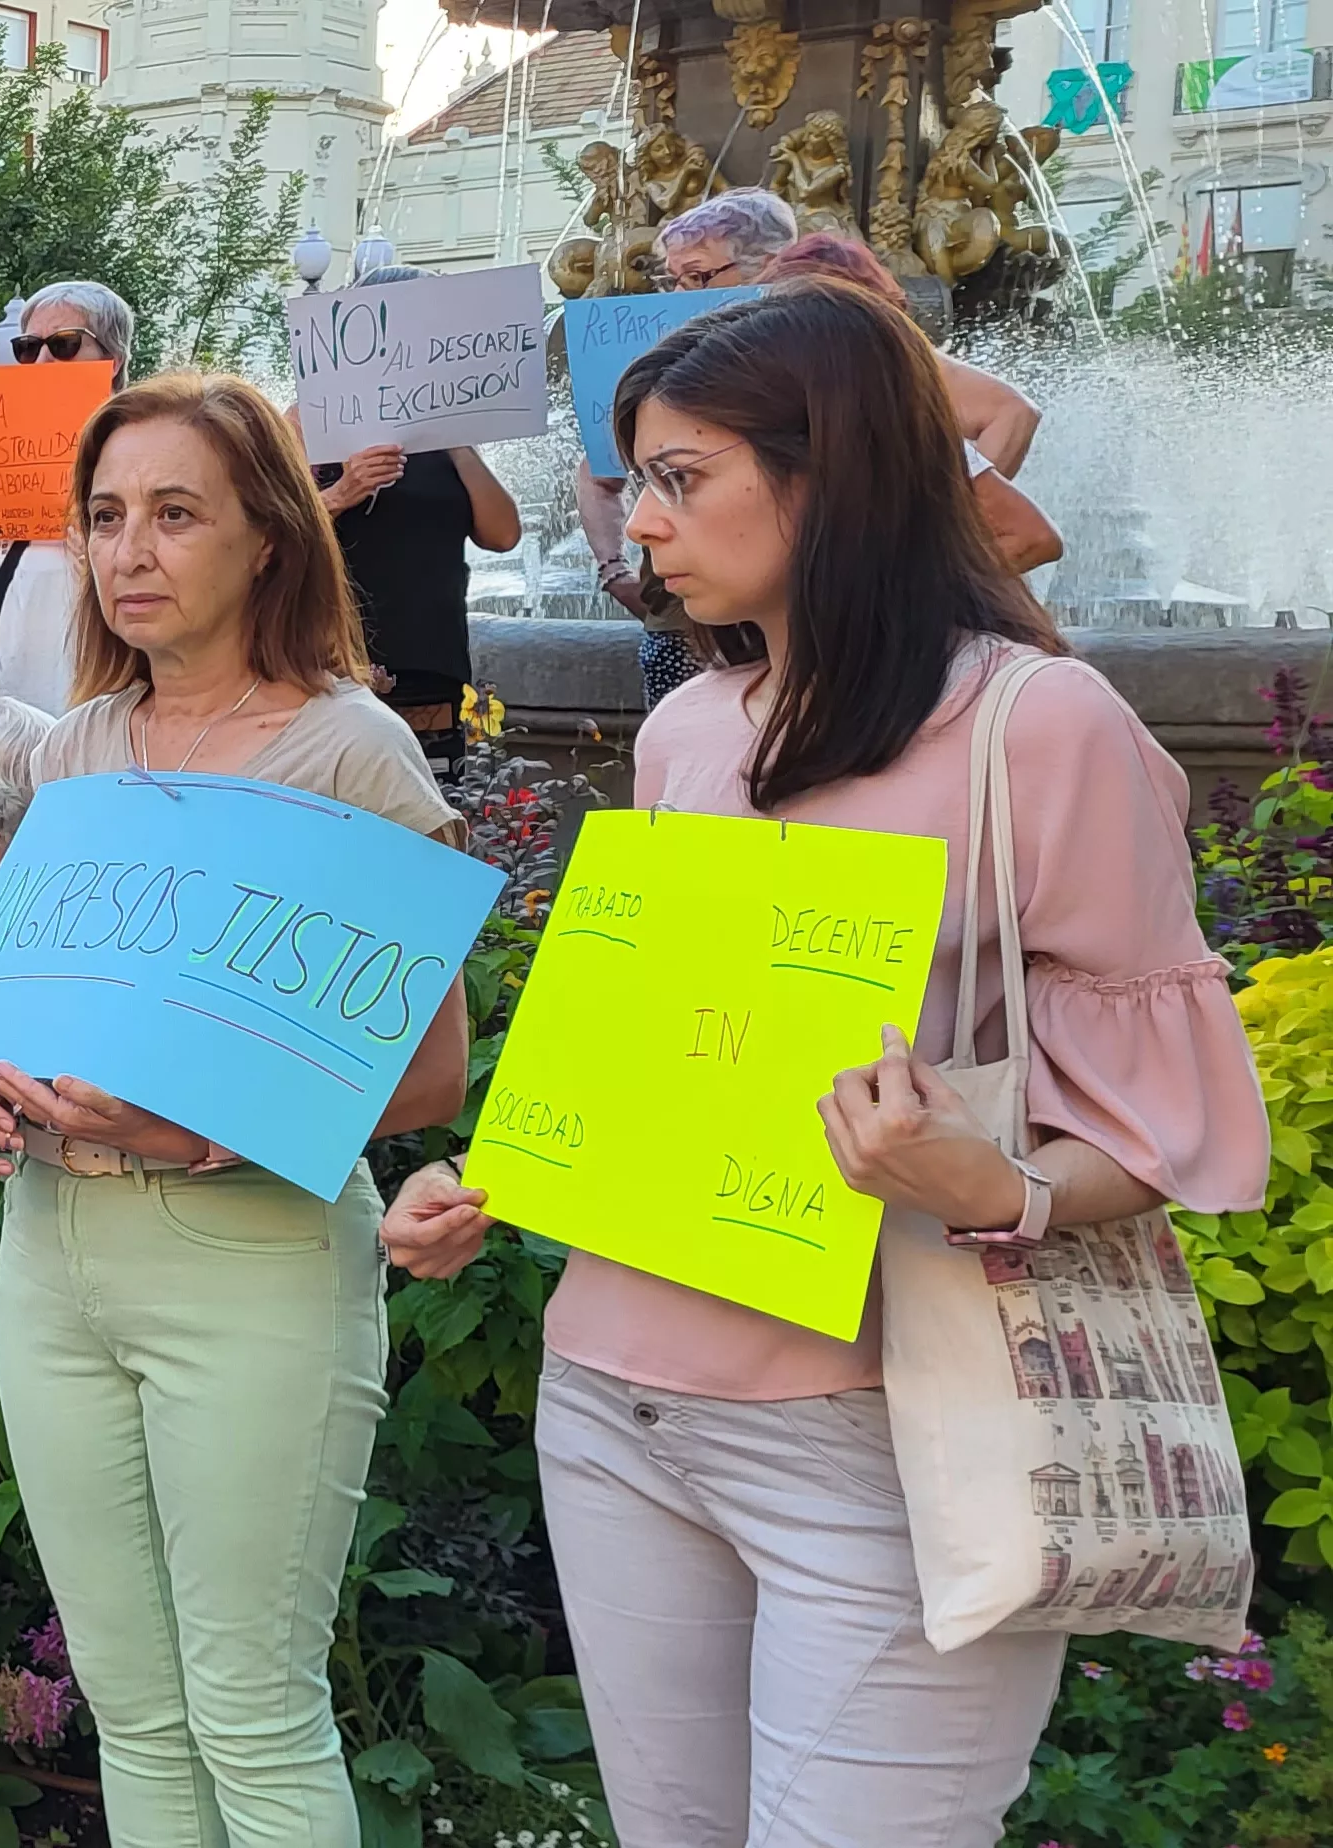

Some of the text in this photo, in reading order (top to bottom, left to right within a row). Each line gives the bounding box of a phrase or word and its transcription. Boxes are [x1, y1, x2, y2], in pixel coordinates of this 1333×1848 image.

[294, 300, 537, 379] ¡NO! AL DESCARTE
[309, 357, 526, 433] Y LA EXCLUSIÓN
[564, 886, 643, 919] TRABAJO
[771, 904, 914, 964] DECENTE
[190, 882, 446, 1042] JUSTOS
[686, 1008, 751, 1065] IN
[489, 1087, 584, 1148] SOCIEDAD
[715, 1153, 825, 1221] DIGNA
